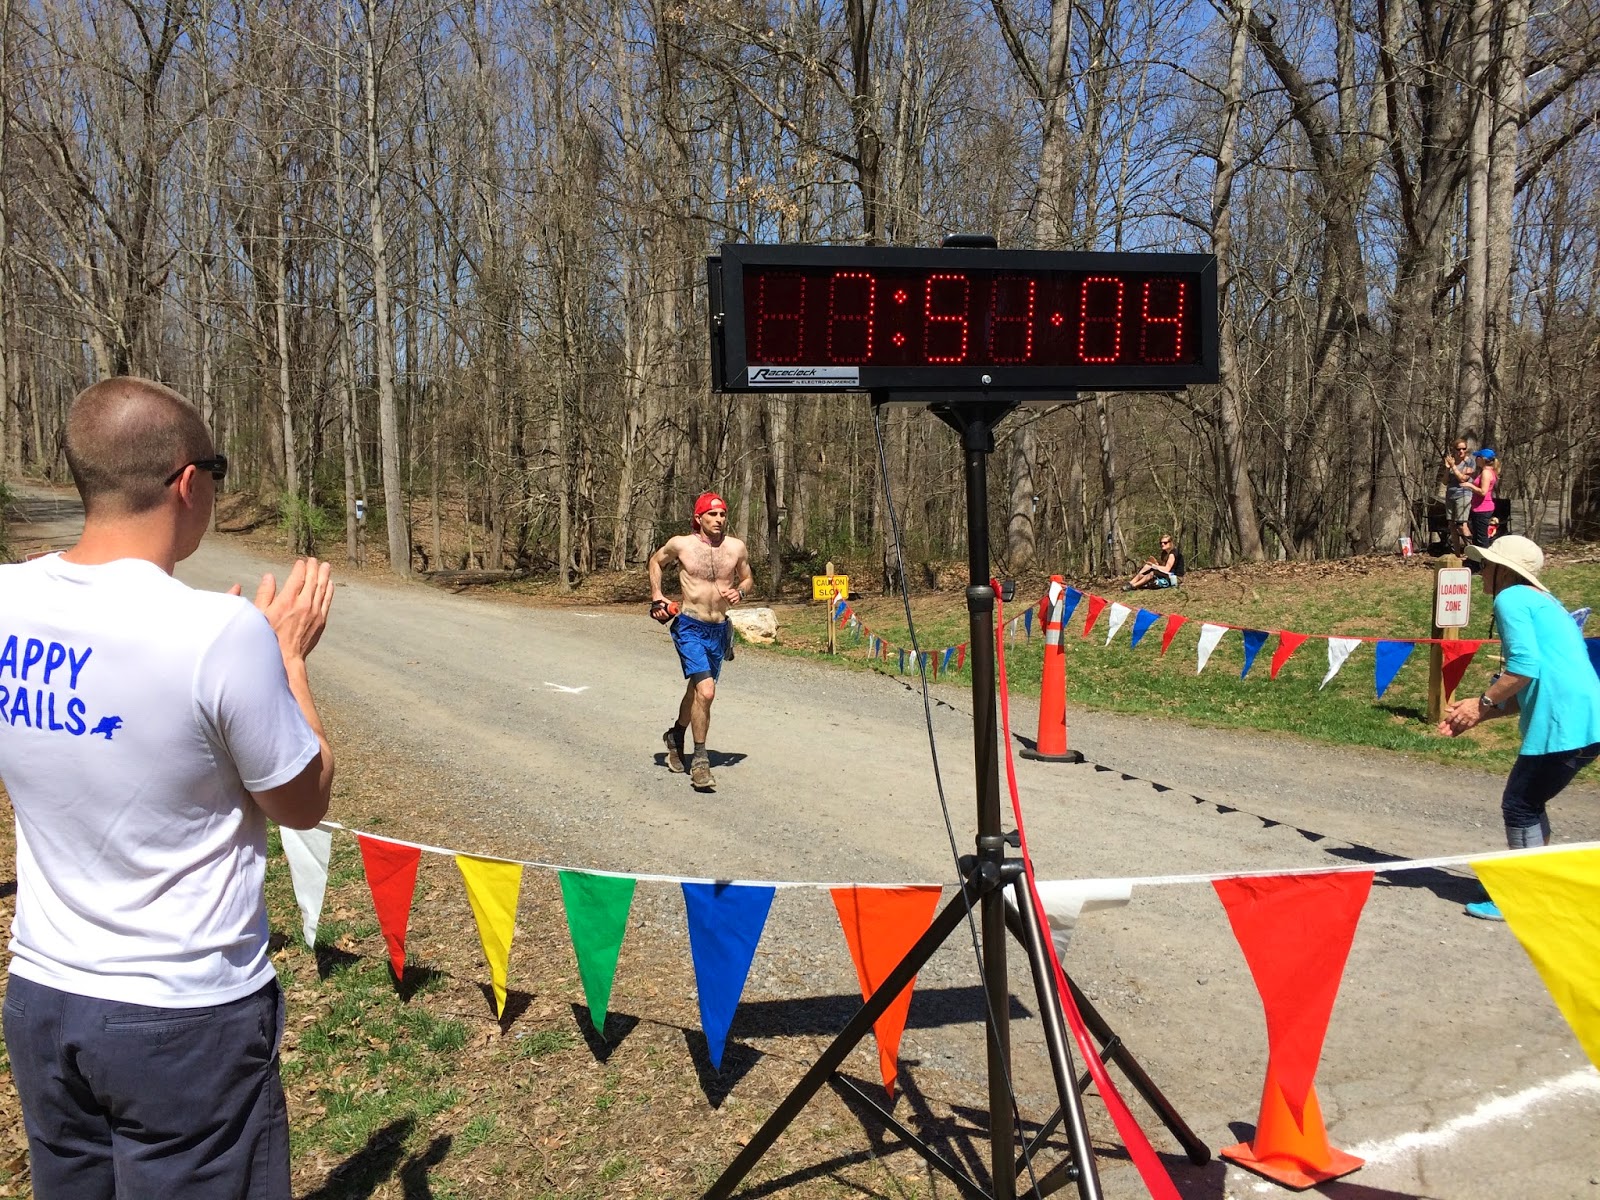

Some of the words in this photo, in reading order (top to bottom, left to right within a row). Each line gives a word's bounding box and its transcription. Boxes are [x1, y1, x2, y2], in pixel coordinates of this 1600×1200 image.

[750, 368, 816, 379] Raceclock
[816, 578, 845, 587] CAUON
[819, 588, 843, 596] SLO
[1440, 584, 1467, 595] LOADING
[1445, 600, 1461, 611] ZONE
